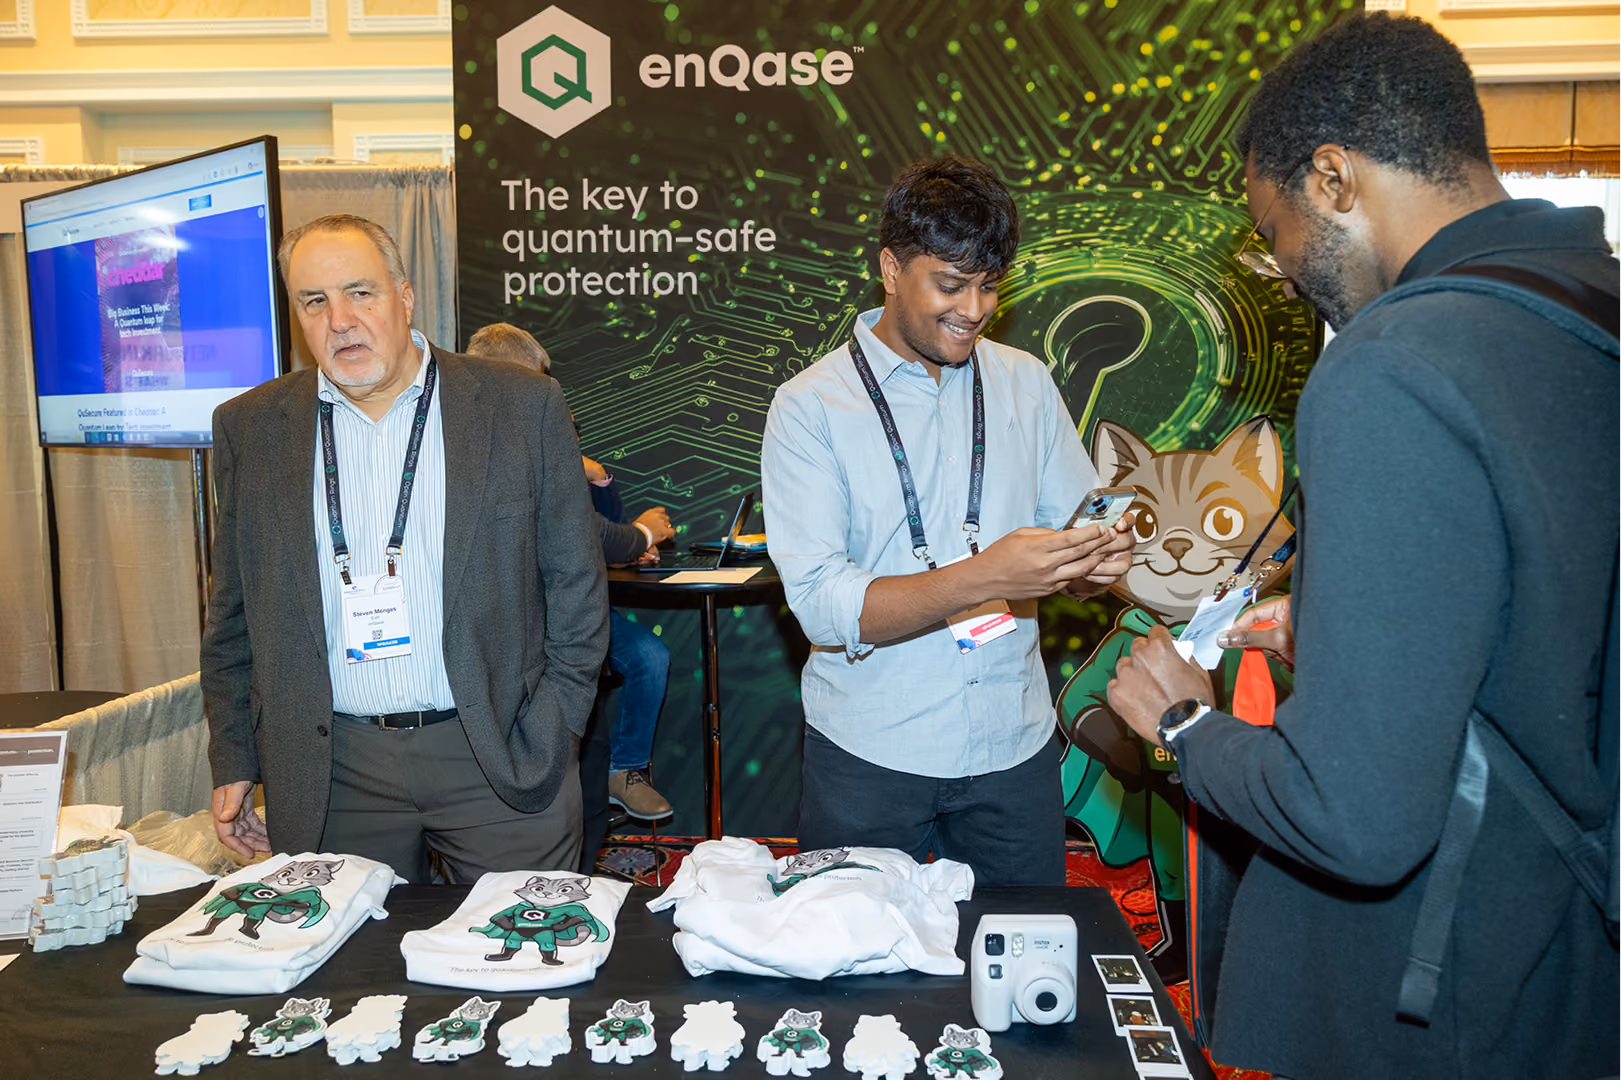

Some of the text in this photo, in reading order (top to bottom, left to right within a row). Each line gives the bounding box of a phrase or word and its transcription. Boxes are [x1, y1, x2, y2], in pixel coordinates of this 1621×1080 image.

[501, 178, 699, 219] The key to
[502, 220, 777, 261] quantum-safe
[505, 262, 698, 304] protection
[114, 319, 120, 328] A
[119, 317, 143, 328] Quantum
[117, 305, 140, 317] Business
[140, 304, 153, 314] This
[427, 371, 435, 384] Open
[861, 367, 876, 392] Quantum
[323, 419, 331, 448] Quantum
[411, 423, 423, 451] Quantum
[879, 404, 901, 451] Open Quantum
[975, 422, 983, 440] Rings
[972, 453, 983, 504] Open Quantum
[328, 477, 340, 525] Quantum Rings
[397, 481, 411, 528] Open Quantum
[905, 484, 916, 515] Quantum
[352, 610, 373, 618] Steven
